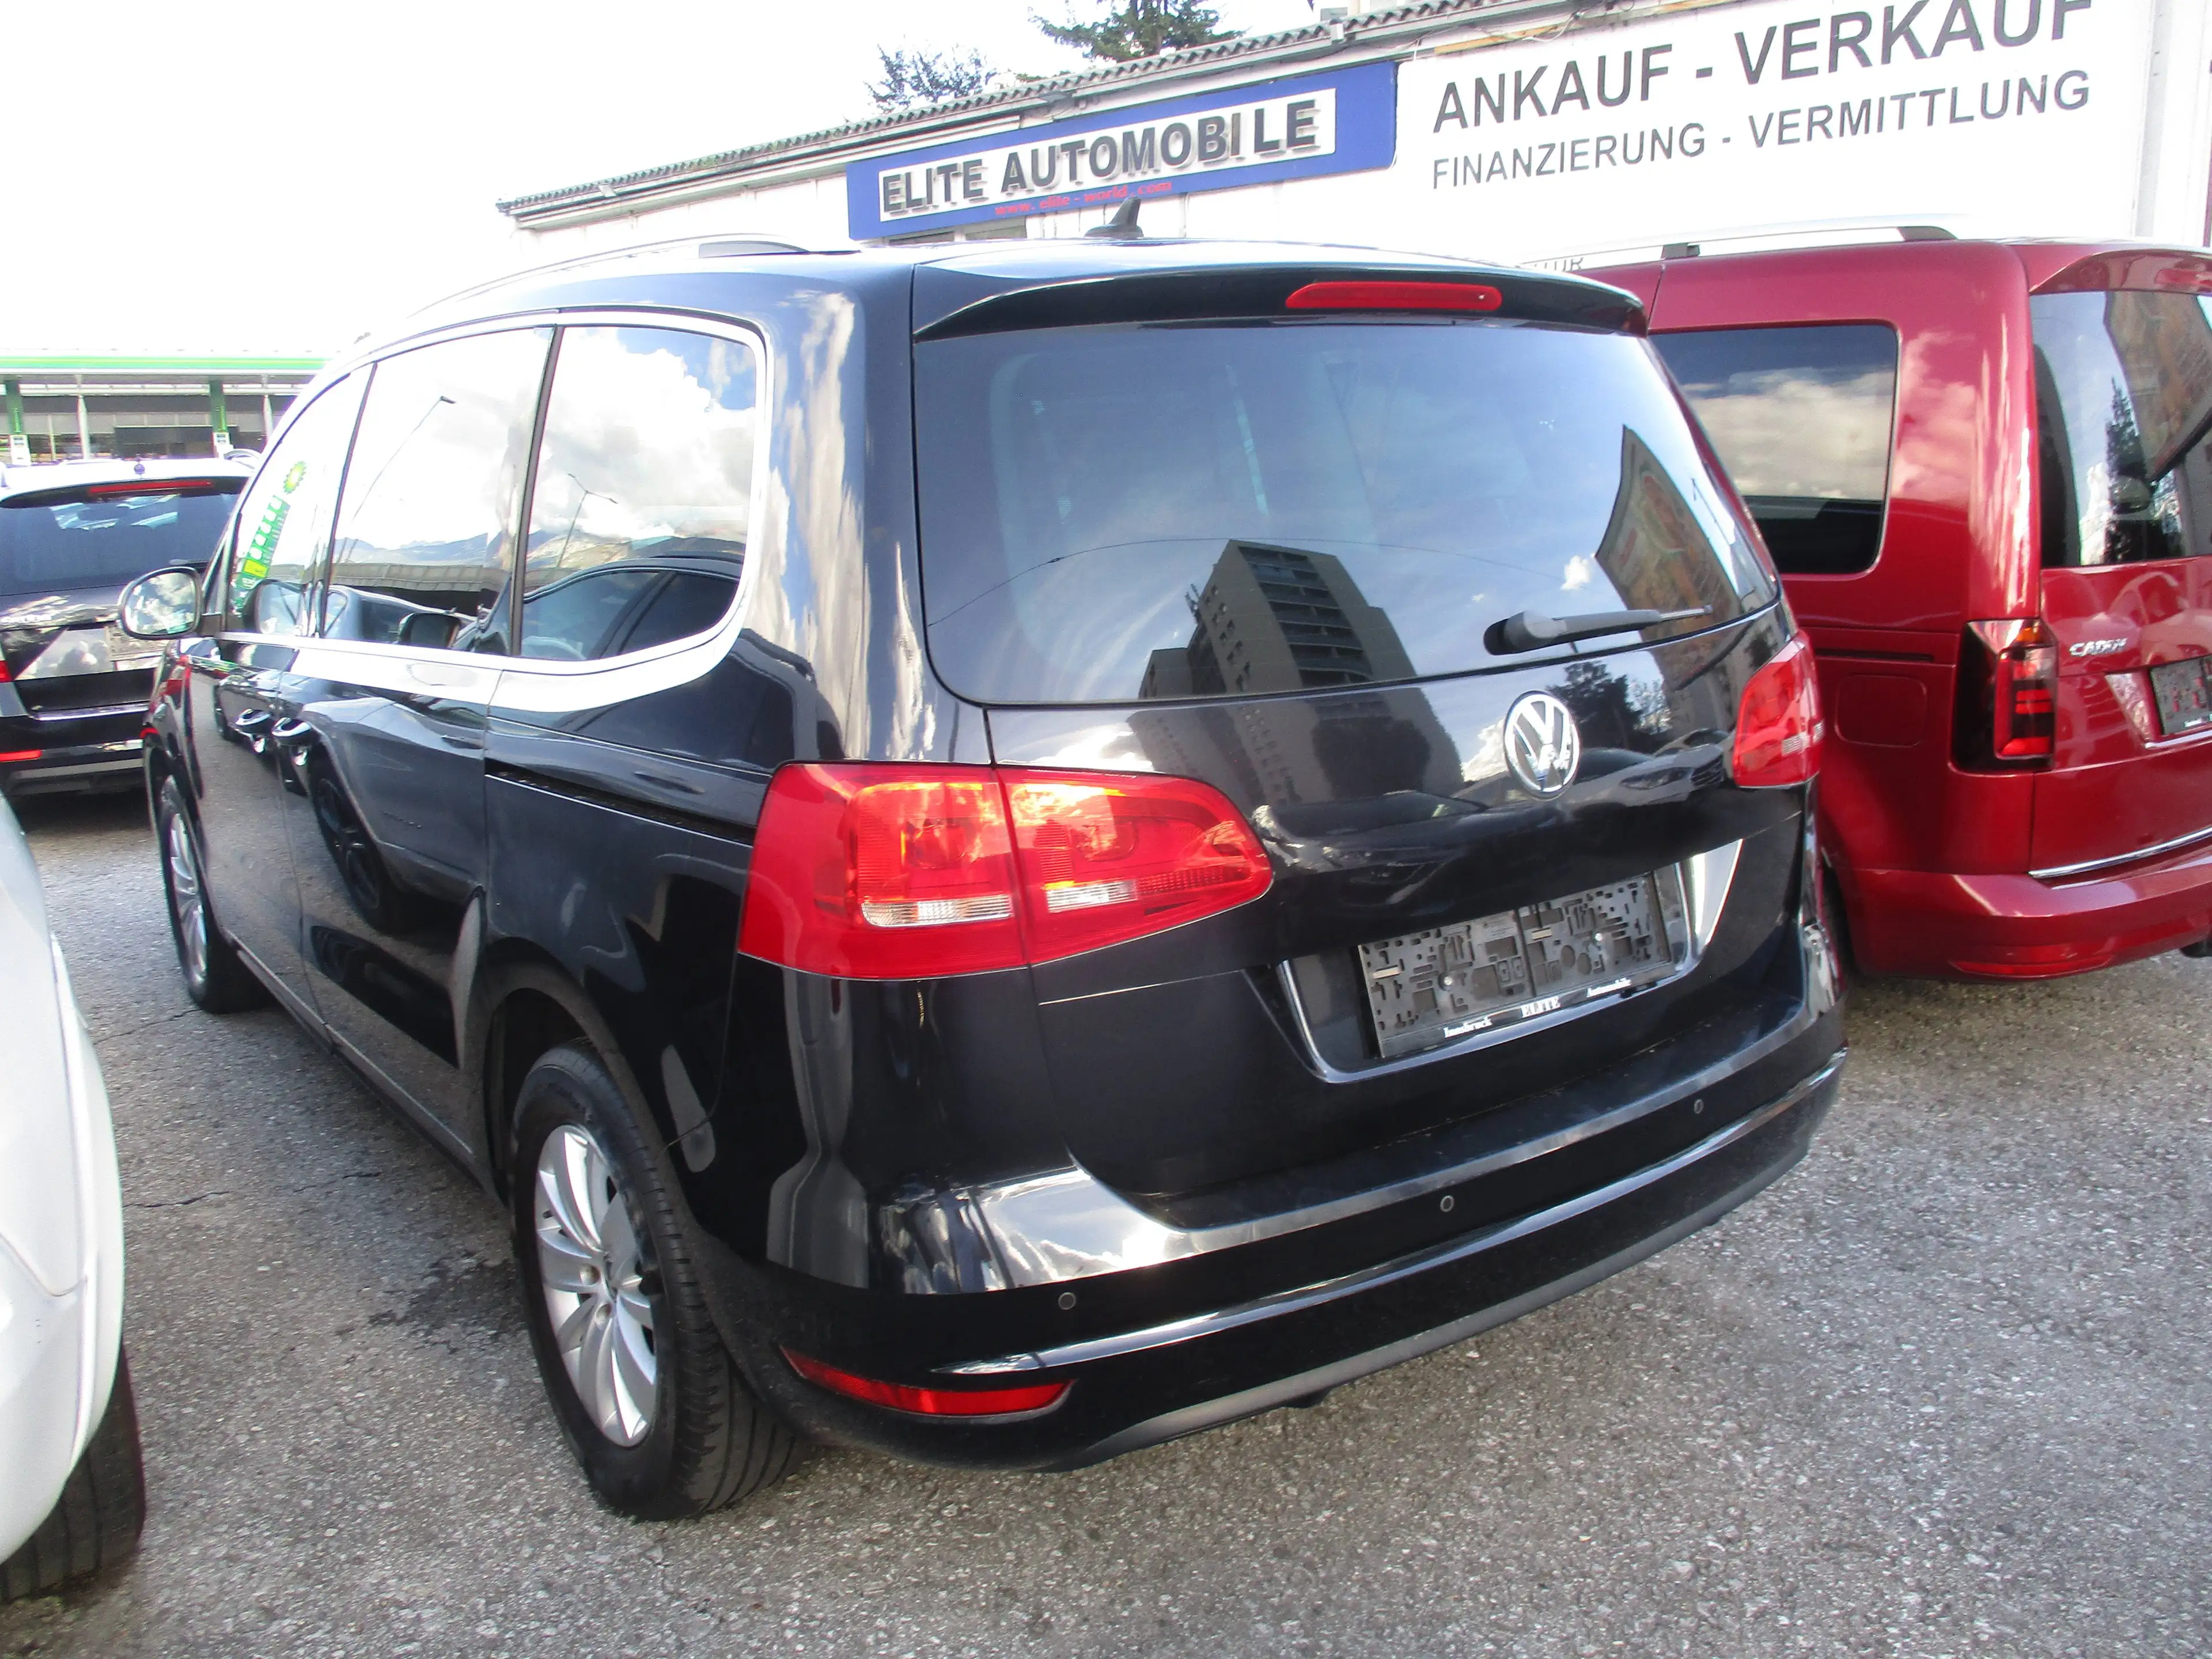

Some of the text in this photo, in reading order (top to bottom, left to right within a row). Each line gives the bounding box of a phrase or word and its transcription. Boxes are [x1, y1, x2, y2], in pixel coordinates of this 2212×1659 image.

[1433, 0, 2092, 133] ANKAUF - VERKAUF
[882, 99, 1316, 213] ELITE AUTOMOBILE
[1433, 123, 1705, 189] FINANZIERUNG
[1748, 70, 2090, 148] VERMITTLUNG
